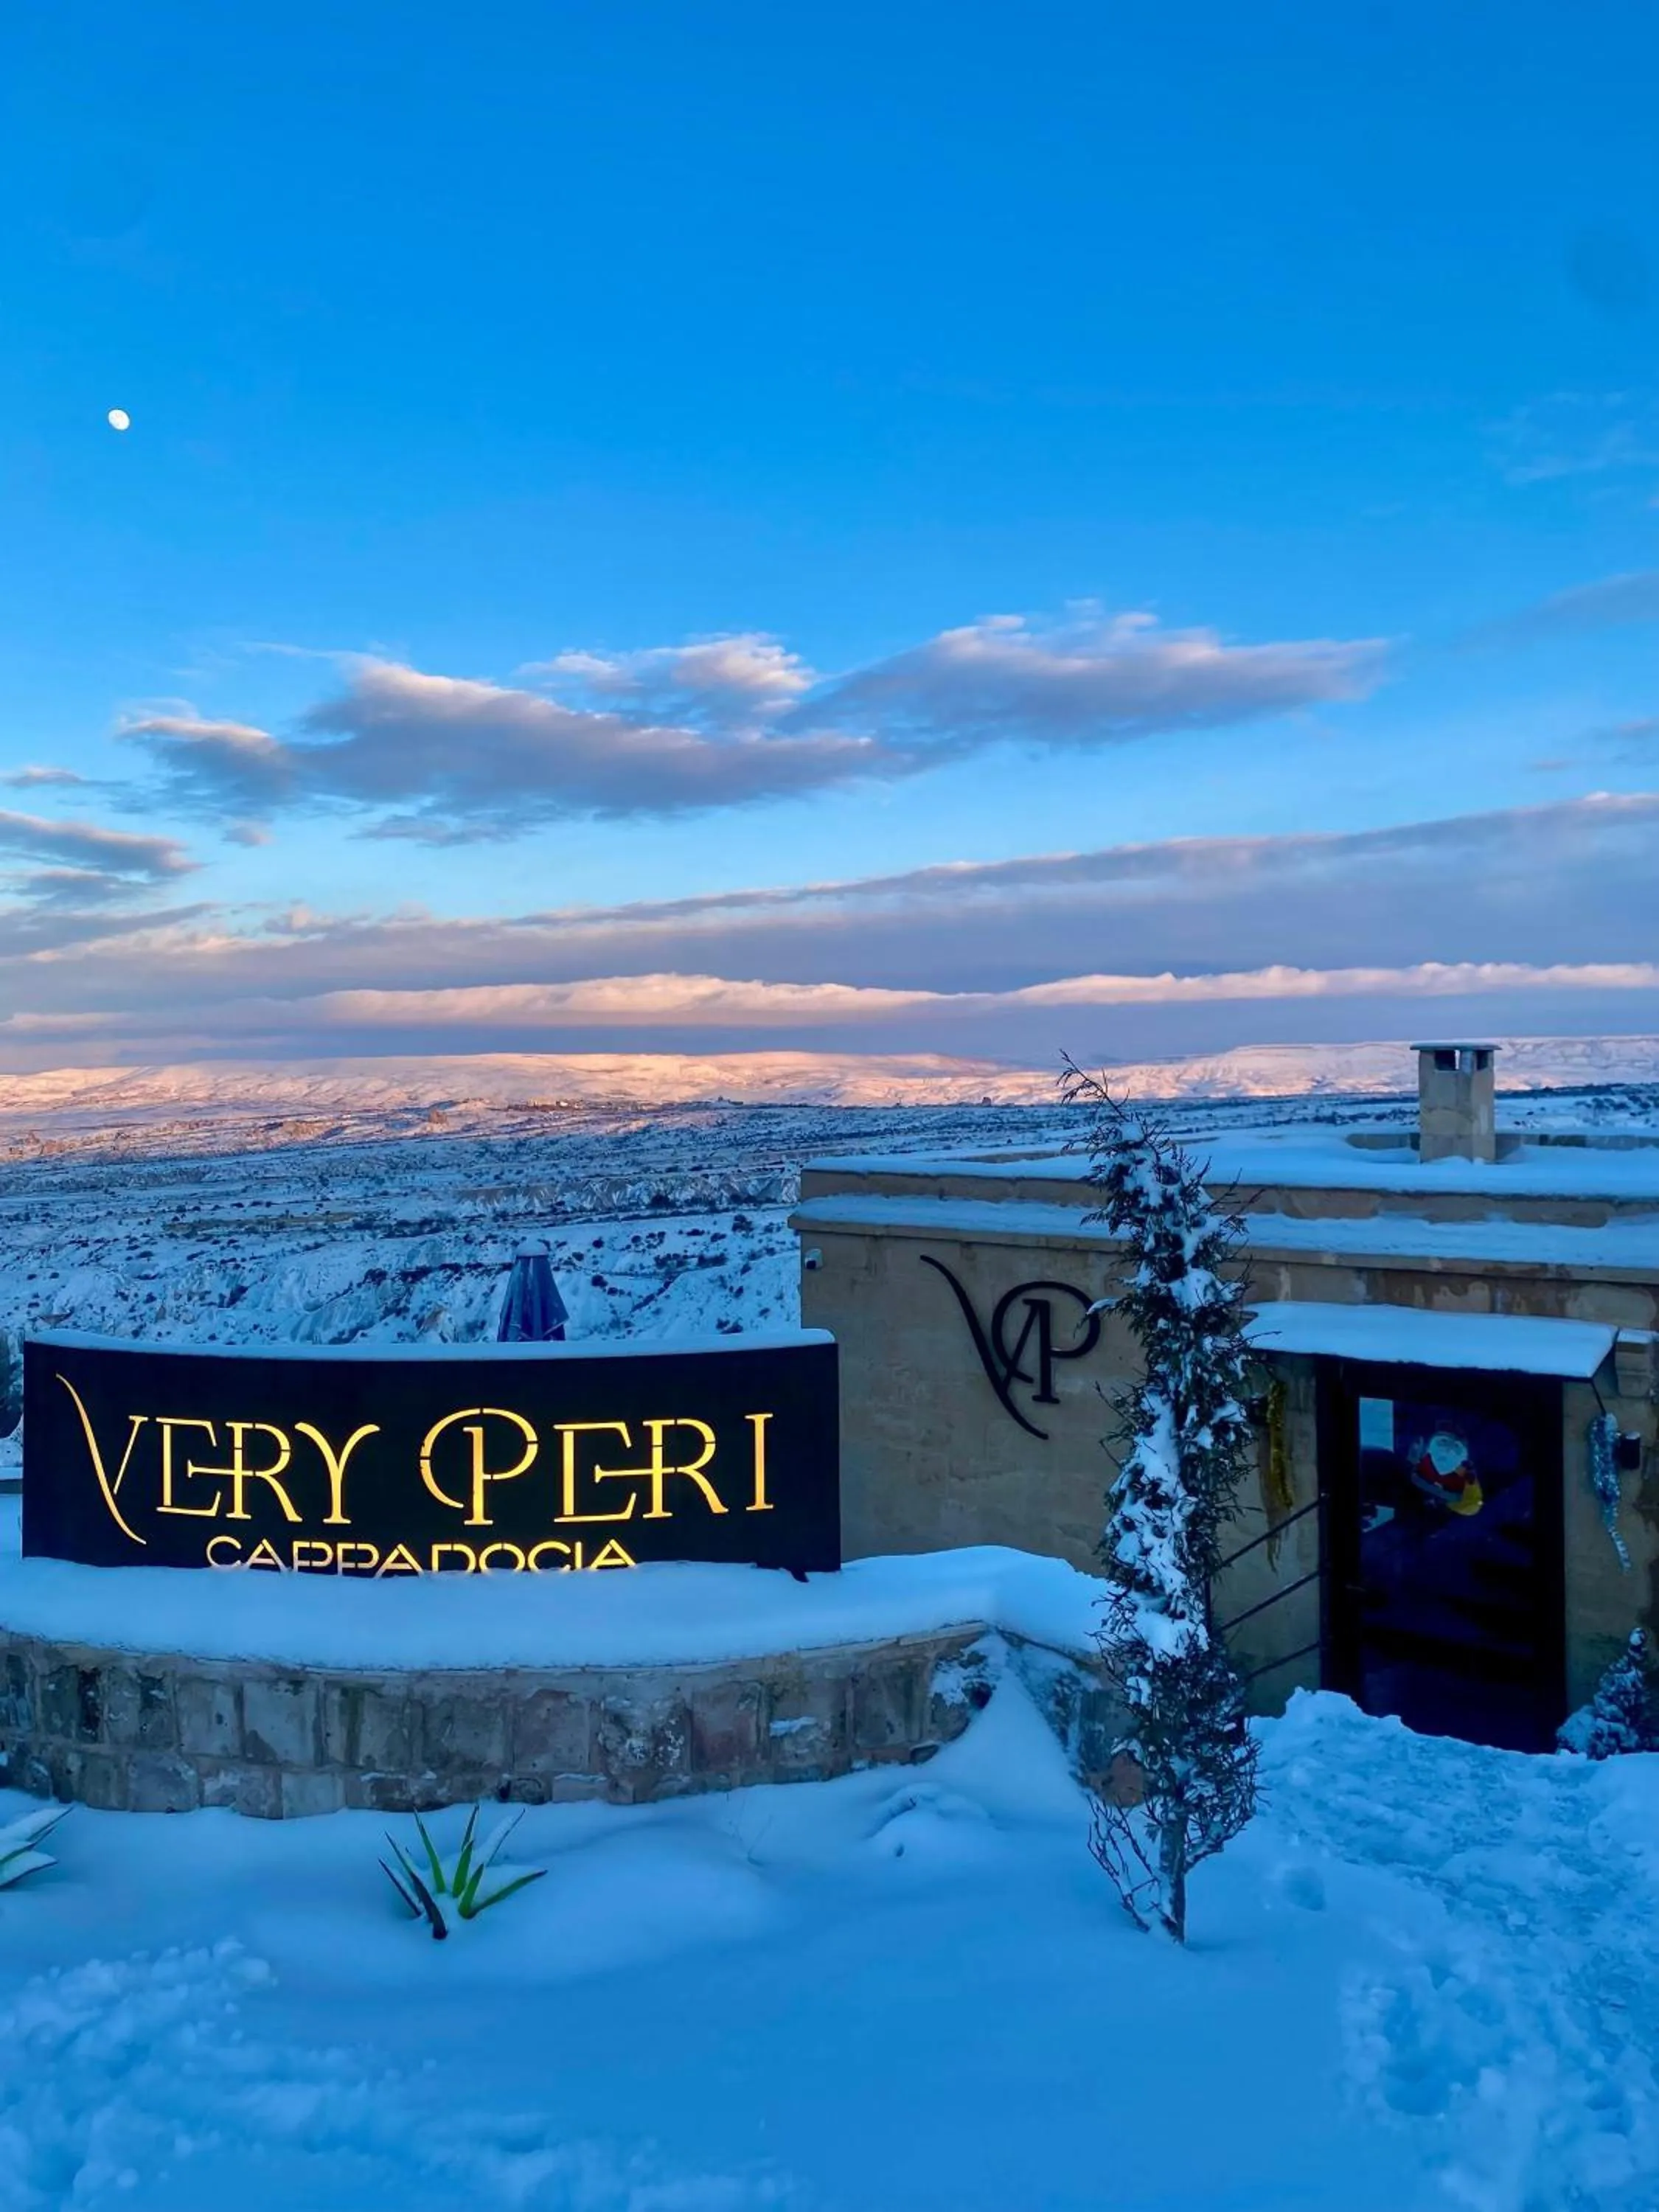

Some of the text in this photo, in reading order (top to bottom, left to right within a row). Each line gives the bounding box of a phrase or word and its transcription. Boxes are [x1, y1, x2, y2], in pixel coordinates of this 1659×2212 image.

[55, 1373, 774, 1545] VERY PERI
[206, 1536, 637, 1578] CAPPADOCIA
